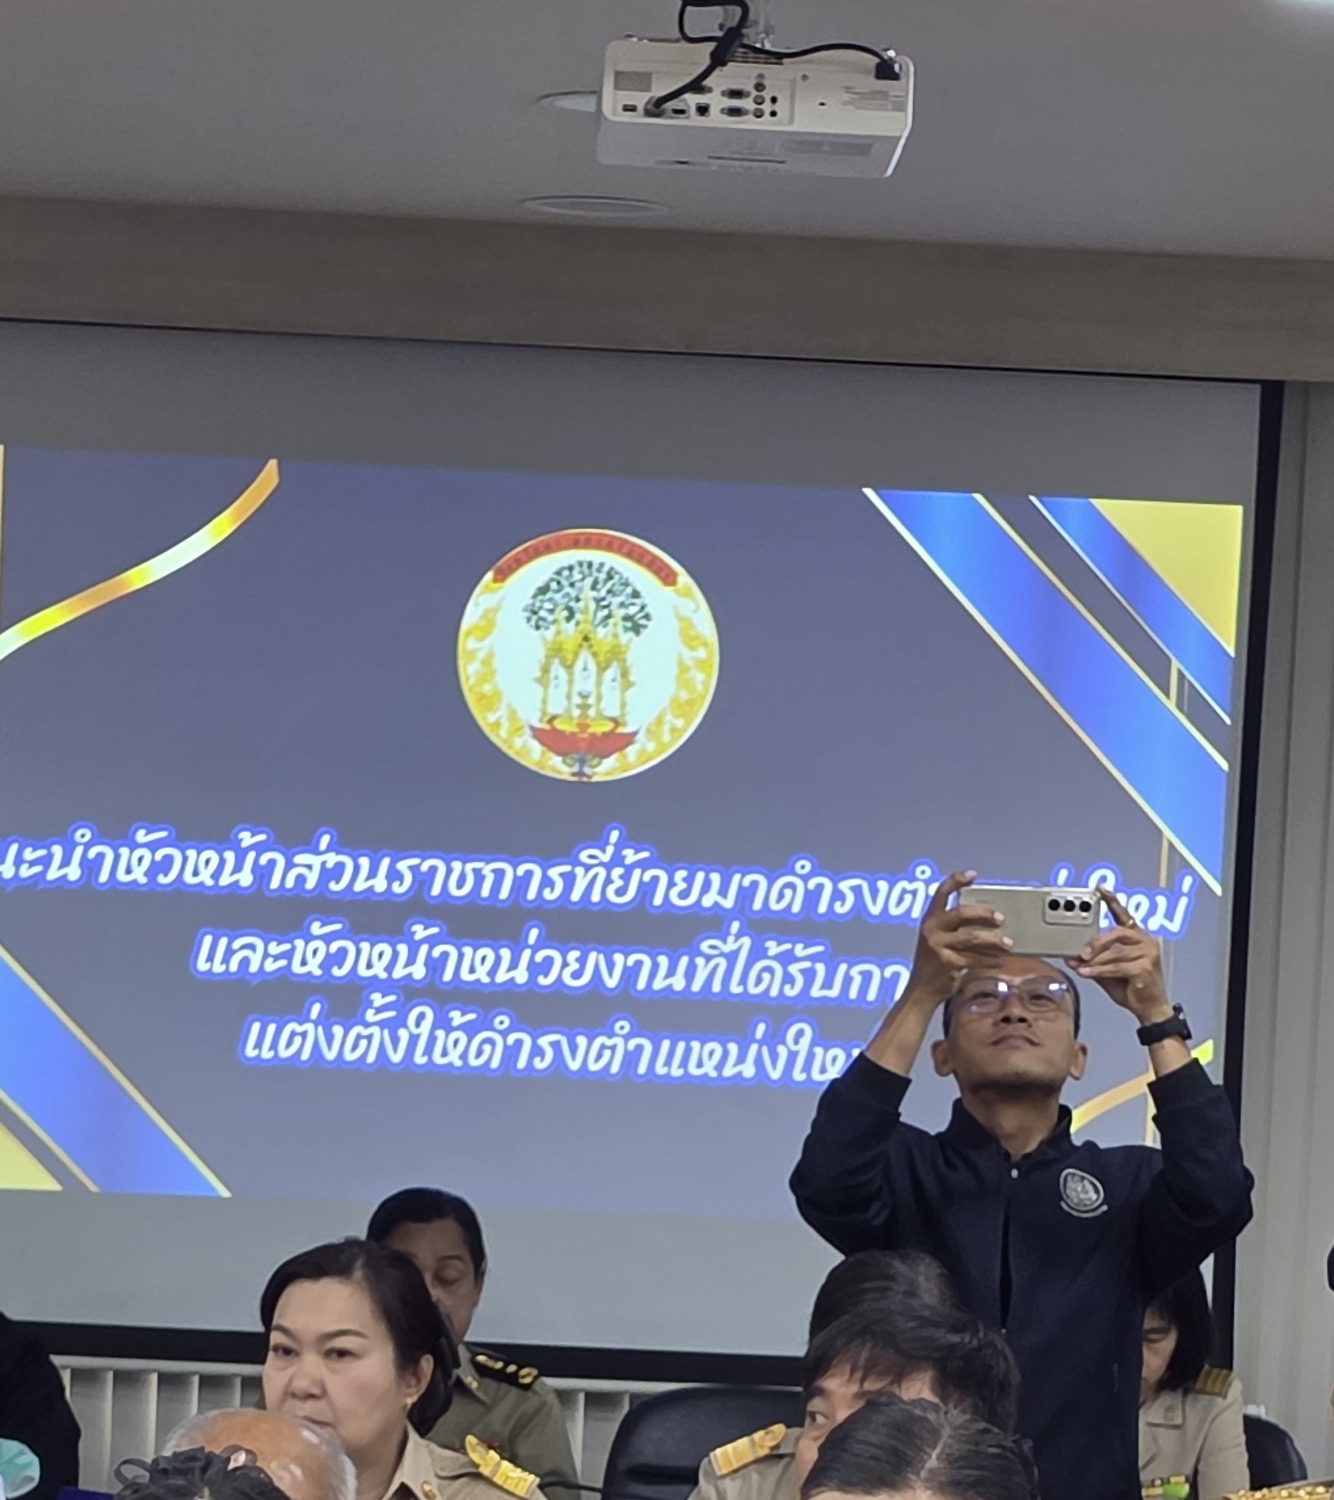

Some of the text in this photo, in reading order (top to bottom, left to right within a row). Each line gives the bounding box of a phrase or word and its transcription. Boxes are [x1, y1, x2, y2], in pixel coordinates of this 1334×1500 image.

[195, 921, 911, 1003] และหัวหน้าหน่วยงานที่ได้รับกา
[244, 994, 862, 1082] แต่งตั้งให้ดำรงตำแหน่งให
